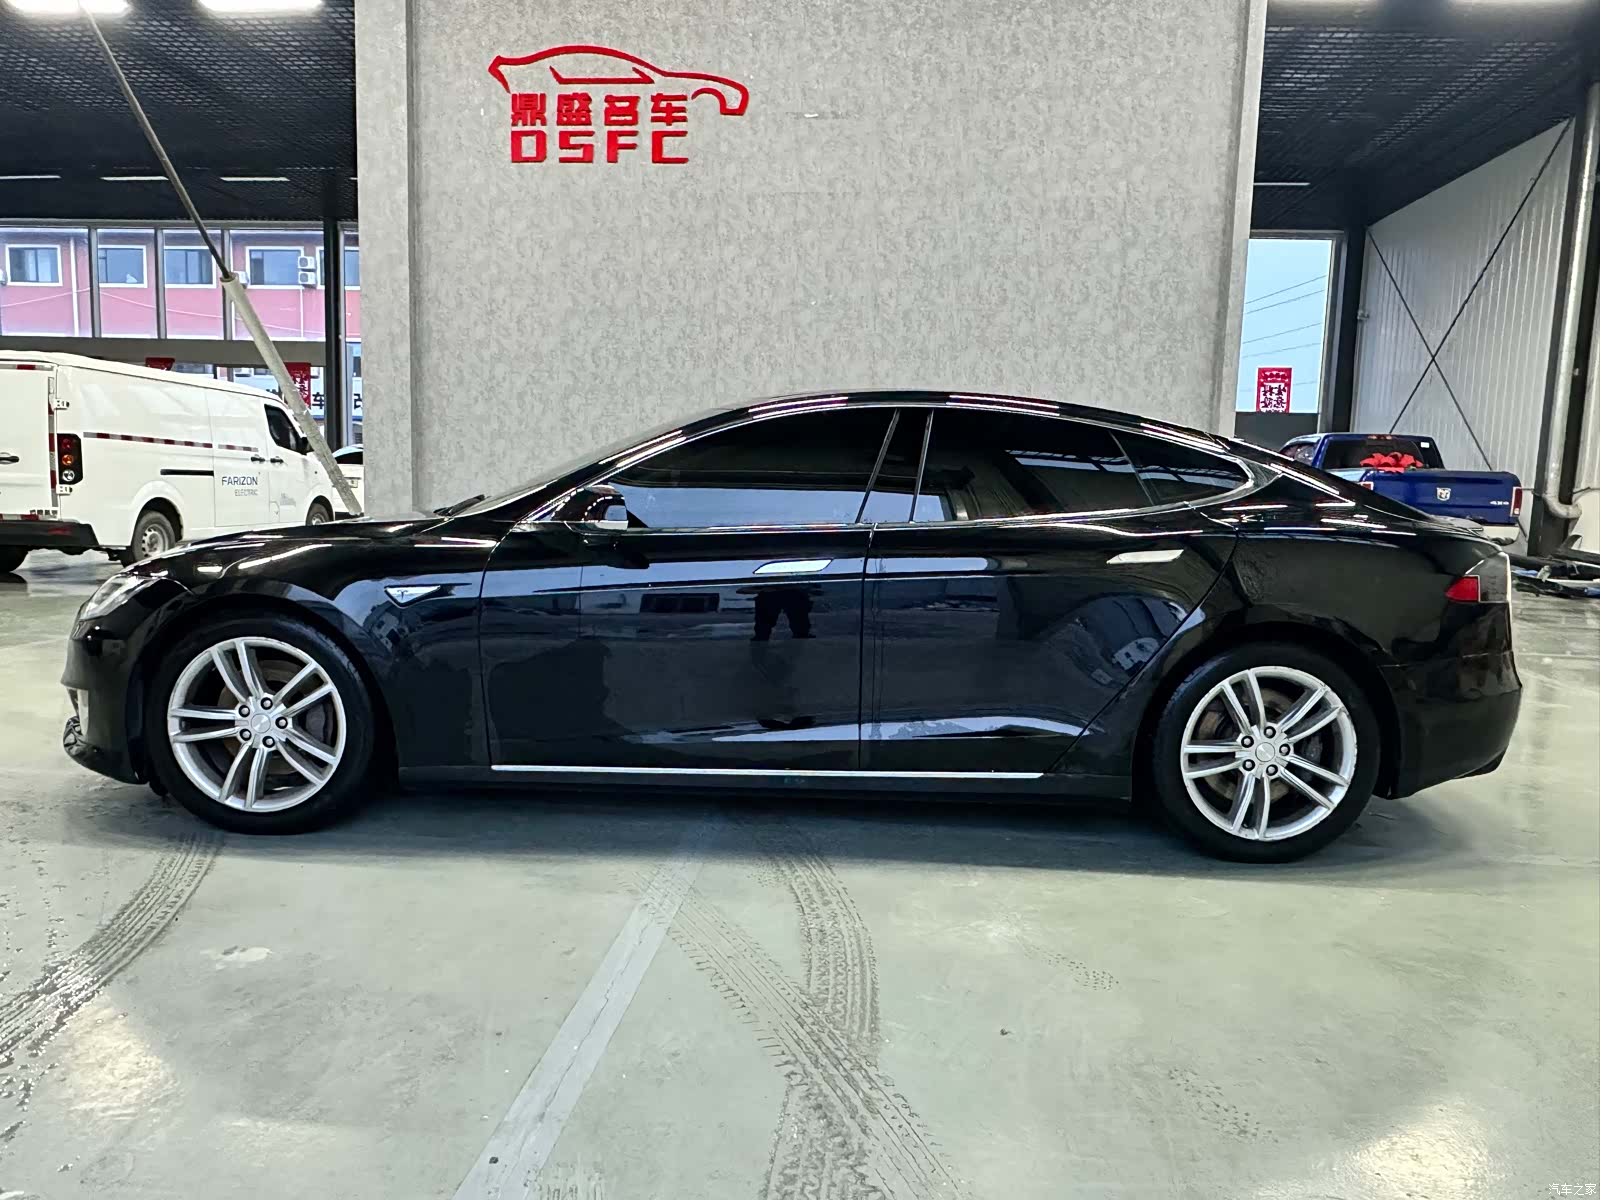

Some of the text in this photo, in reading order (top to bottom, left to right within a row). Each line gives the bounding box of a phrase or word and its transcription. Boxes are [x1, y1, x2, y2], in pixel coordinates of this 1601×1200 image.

[511, 93, 688, 126] 鼎盛名车
[511, 130, 689, 163] DSFC
[221, 476, 258, 486] FARIZON
[234, 488, 259, 497] ELECTRIC
